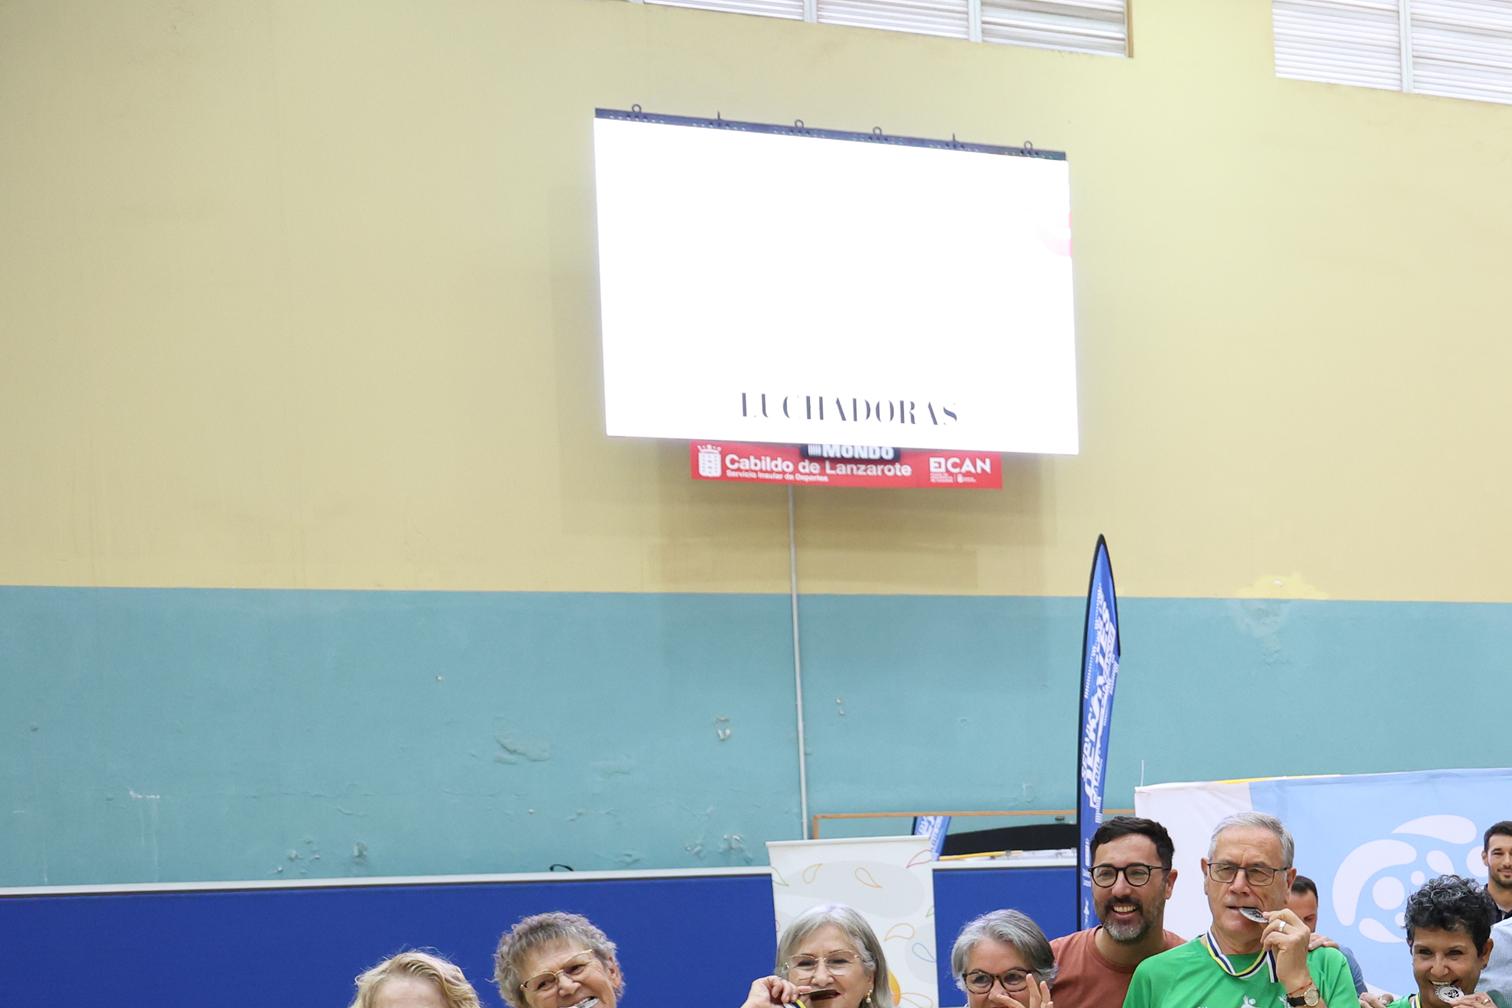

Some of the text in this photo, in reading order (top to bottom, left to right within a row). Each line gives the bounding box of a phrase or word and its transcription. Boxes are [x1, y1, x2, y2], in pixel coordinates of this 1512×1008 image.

[742, 392, 957, 425] LUCHADORAS
[823, 444, 894, 459] MONDO
[725, 454, 912, 477] Cabildo de Lanzarote
